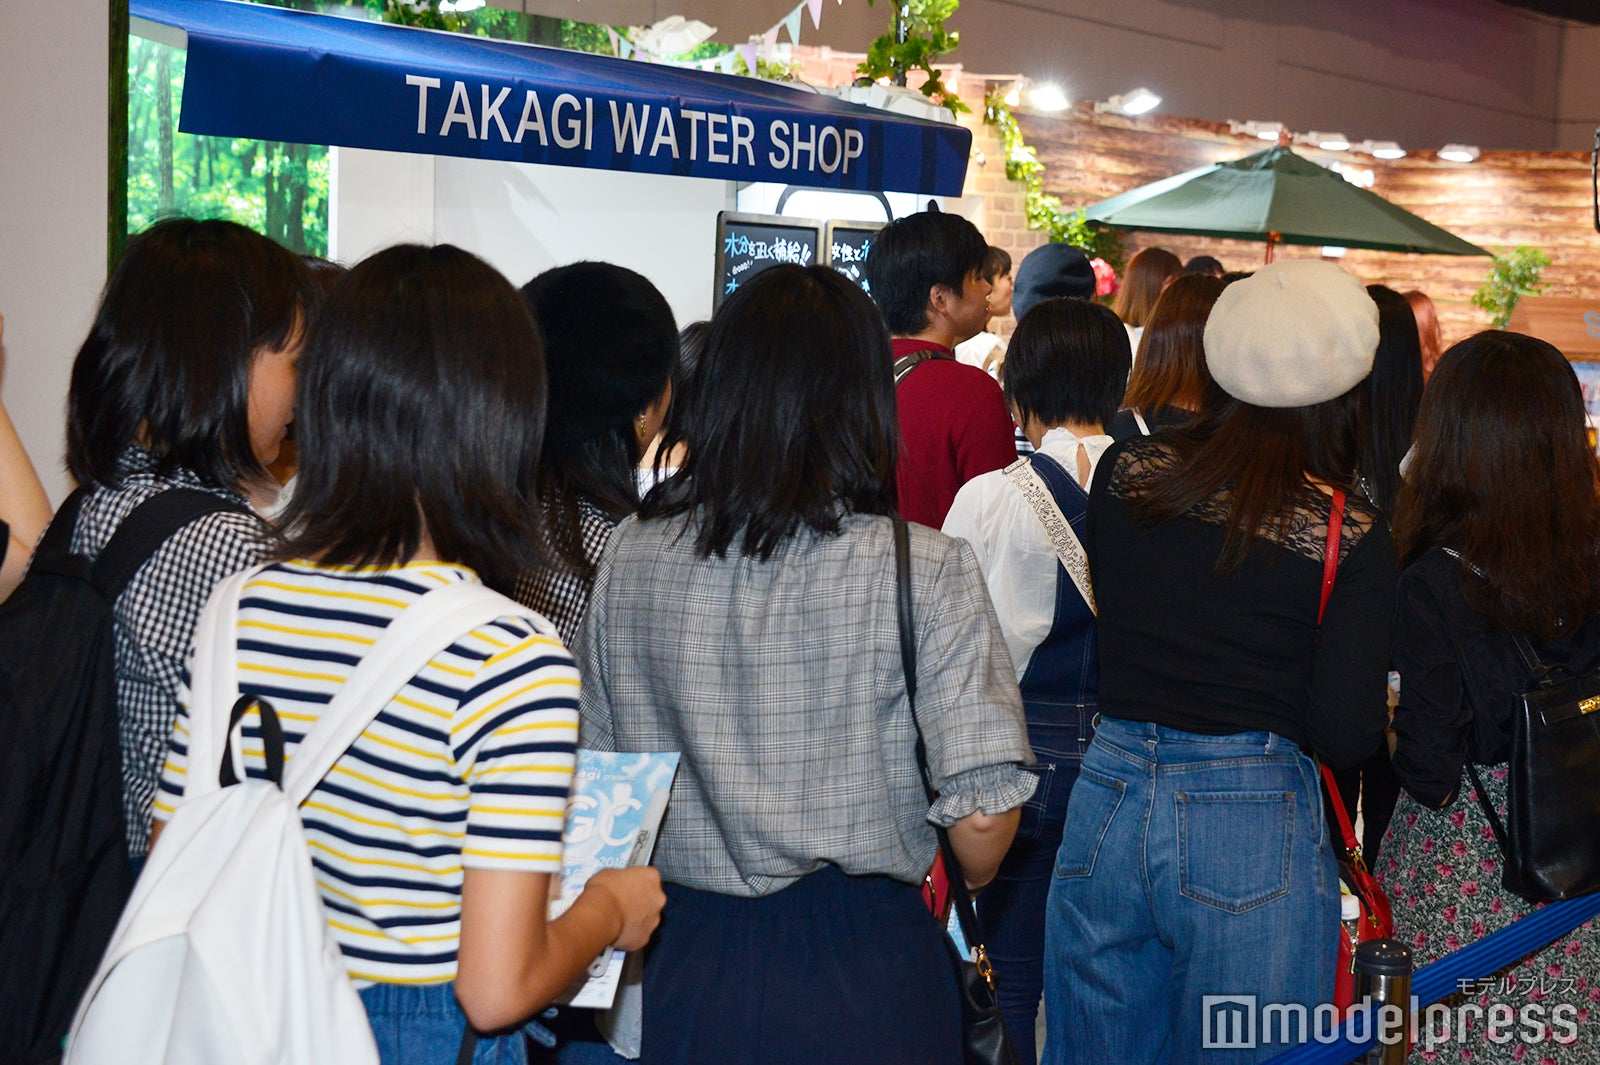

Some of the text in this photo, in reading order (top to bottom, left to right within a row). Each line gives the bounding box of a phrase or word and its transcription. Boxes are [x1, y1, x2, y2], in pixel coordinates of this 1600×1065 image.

[405, 73, 865, 175] TAKAGI WATER SHOP
